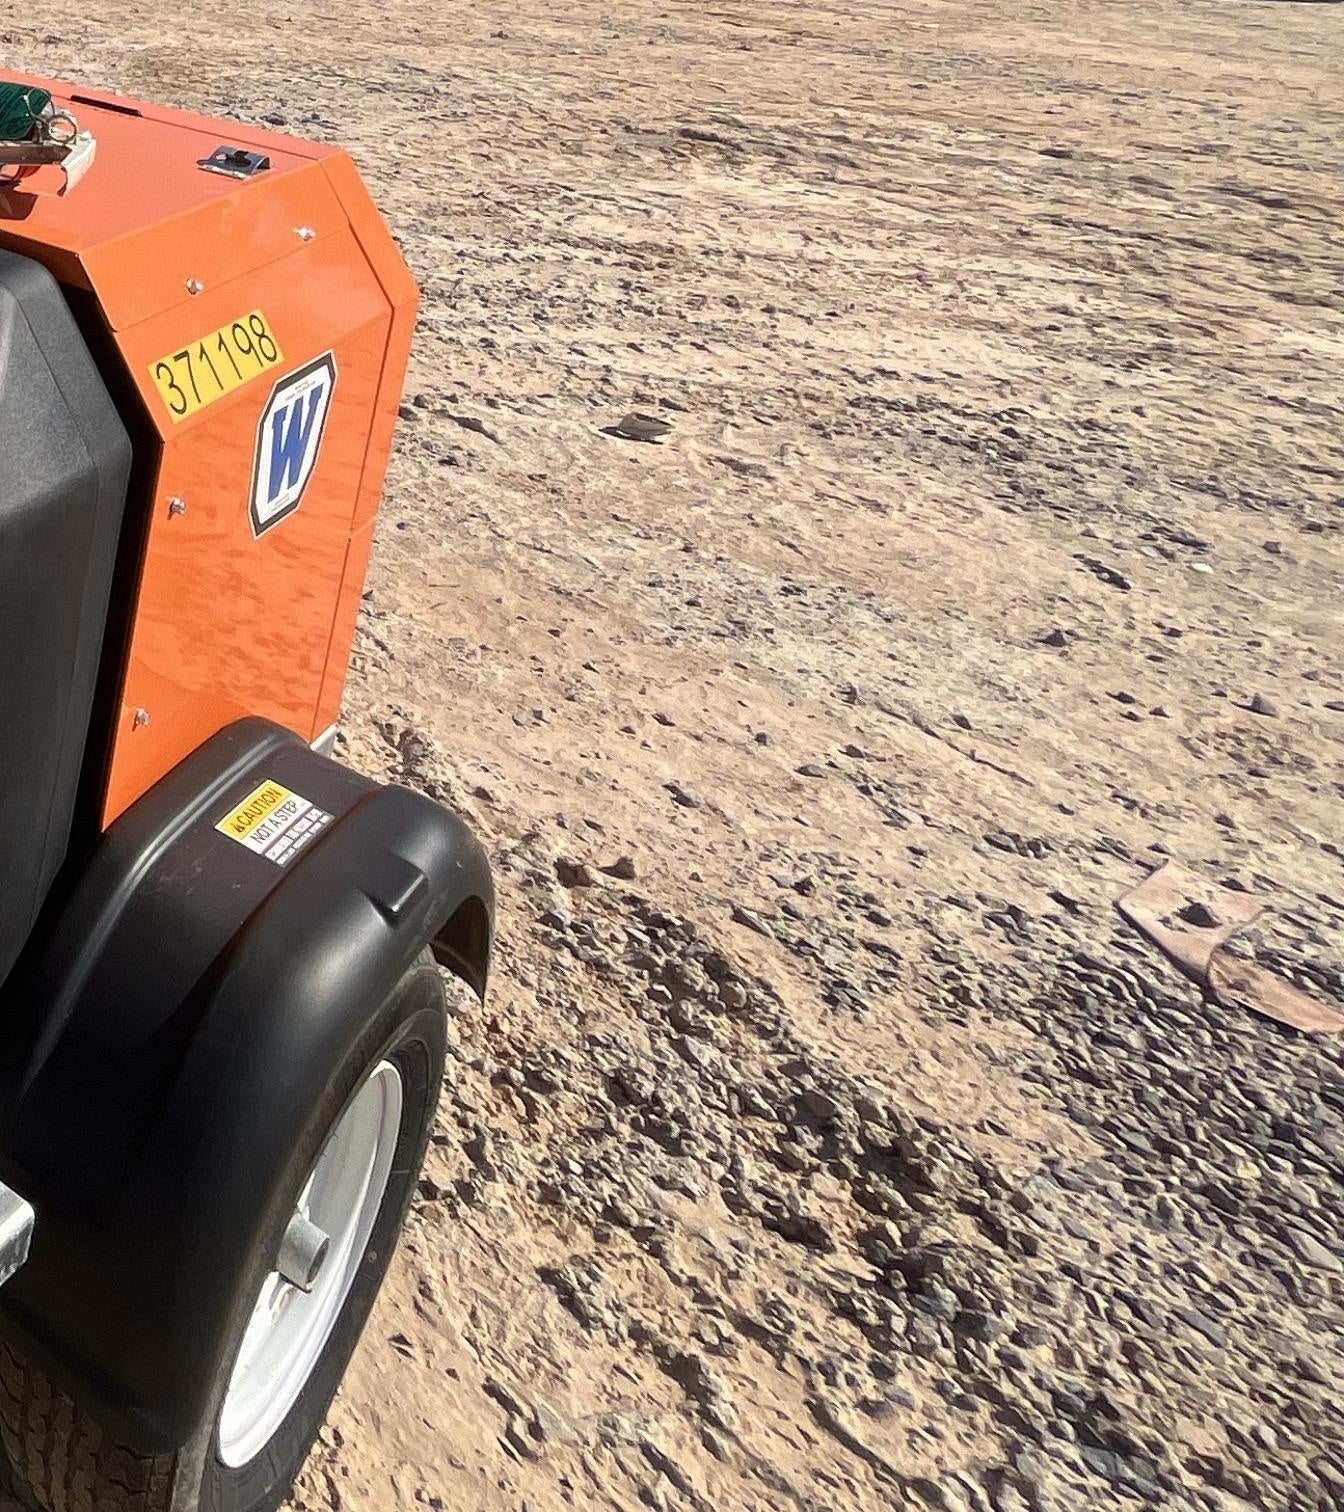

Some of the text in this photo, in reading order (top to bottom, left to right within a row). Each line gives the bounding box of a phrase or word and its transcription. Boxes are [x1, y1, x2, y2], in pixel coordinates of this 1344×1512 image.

[155, 314, 278, 415] 371198
[266, 381, 325, 504] W
[236, 787, 284, 826] CAUTION
[250, 822, 272, 845] NOT
[275, 799, 298, 822] STEP
